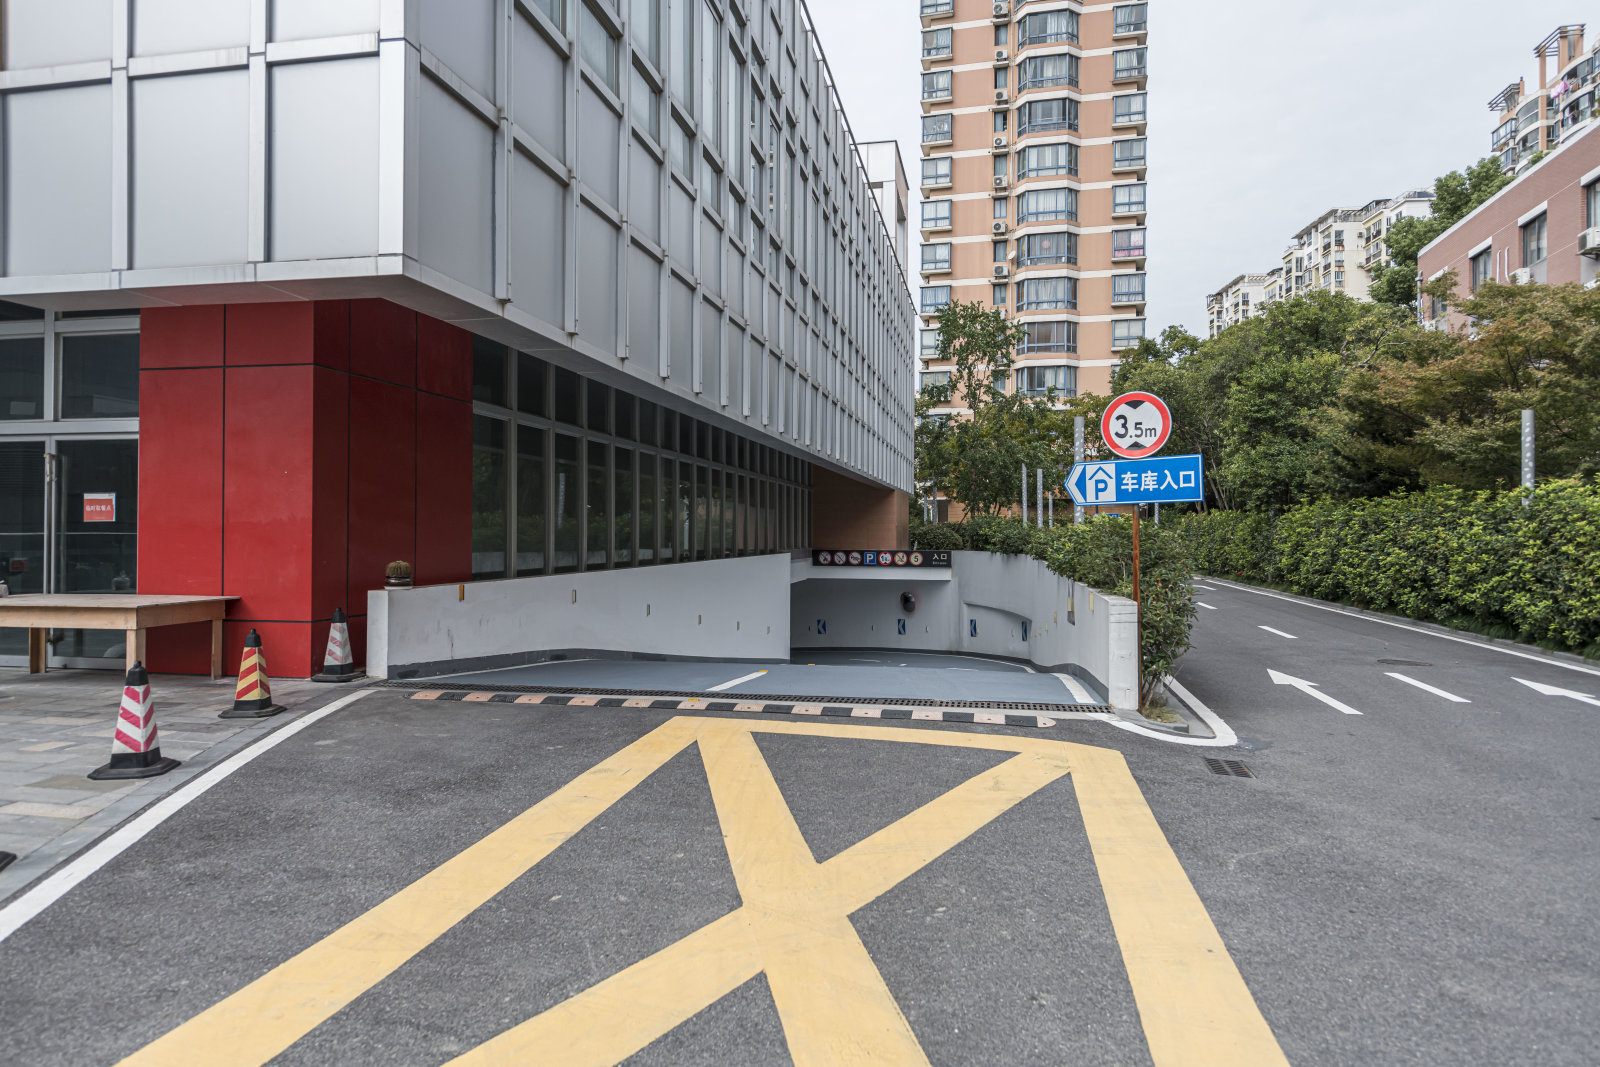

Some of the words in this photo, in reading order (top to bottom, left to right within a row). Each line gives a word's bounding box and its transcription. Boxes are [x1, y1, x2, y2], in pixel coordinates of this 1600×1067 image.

[1114, 414, 1157, 439] 3.5m
[1094, 479, 1109, 501] P
[1120, 469, 1196, 492] 车库入口
[866, 553, 874, 564] P
[913, 555, 919, 563] 5
